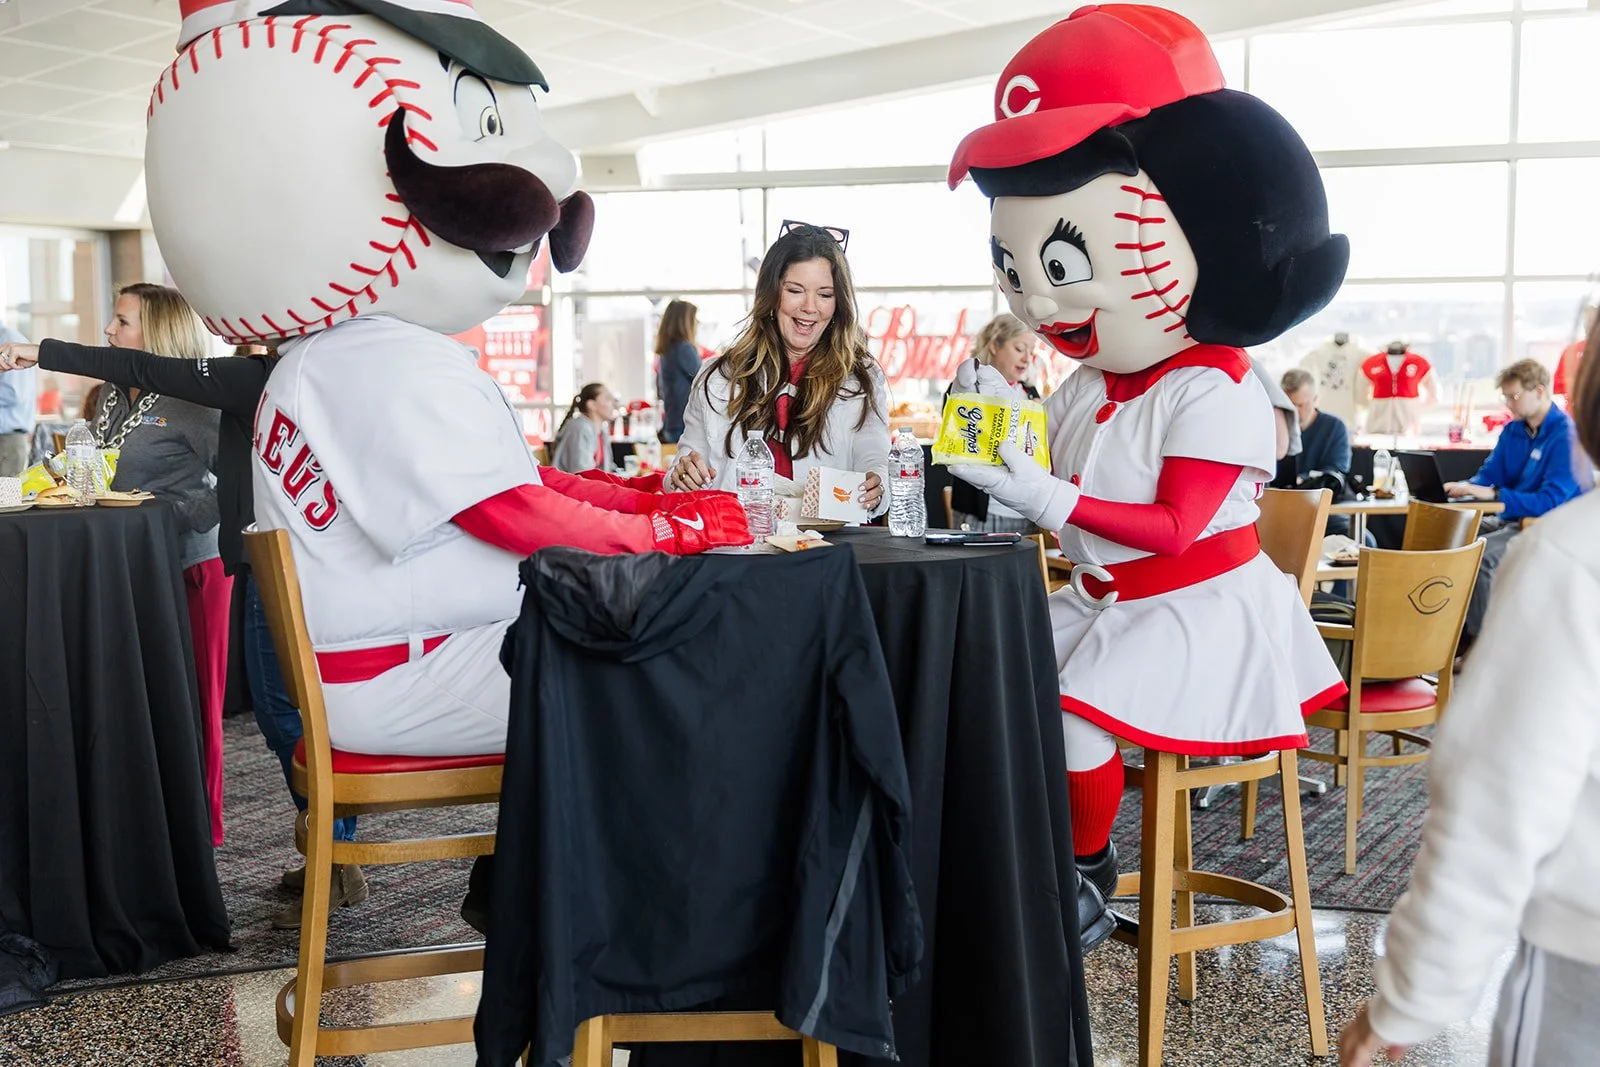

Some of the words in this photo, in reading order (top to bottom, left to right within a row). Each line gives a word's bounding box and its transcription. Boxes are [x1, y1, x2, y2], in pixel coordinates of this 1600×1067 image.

[999, 74, 1041, 119] C
[995, 408, 1005, 438] POTATO
[991, 440, 1000, 462] CHIPS
[1408, 575, 1453, 615] C
